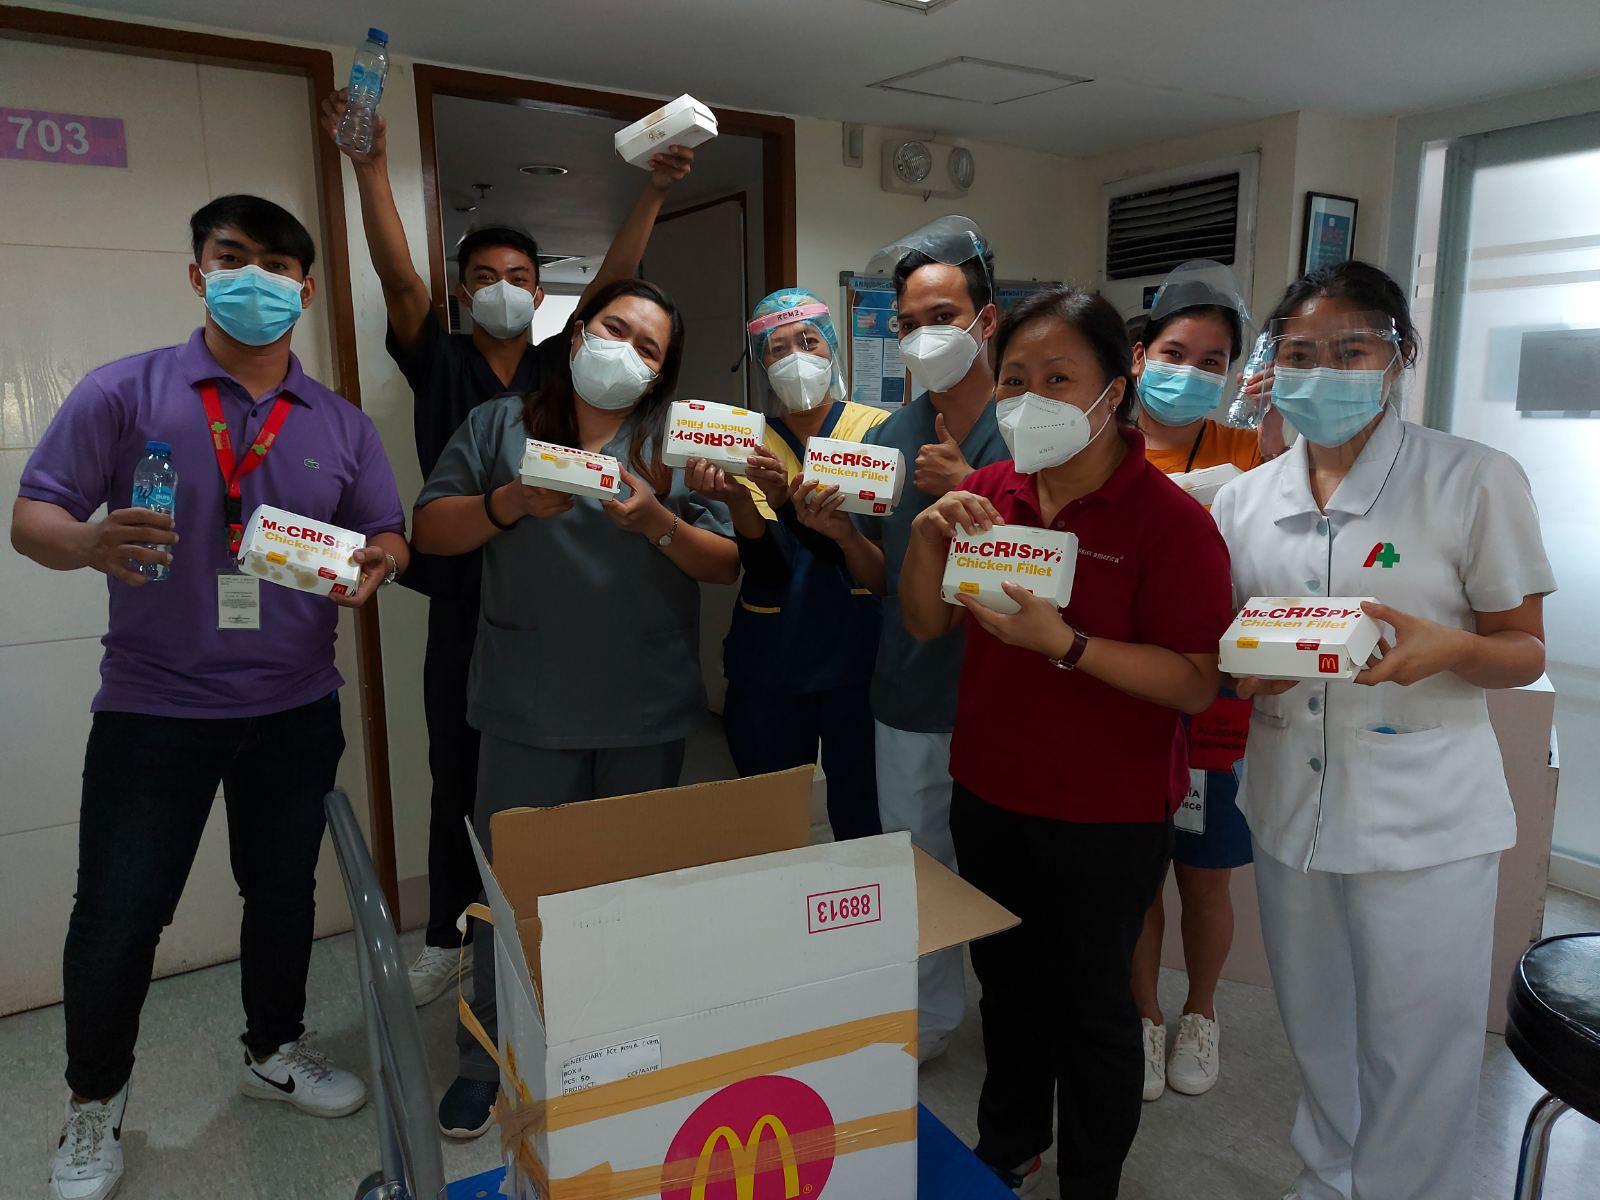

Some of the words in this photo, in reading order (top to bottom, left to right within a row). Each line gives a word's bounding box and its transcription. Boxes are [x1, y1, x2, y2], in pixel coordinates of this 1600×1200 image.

[8, 116, 89, 155] 703
[676, 418, 704, 430] Fillet
[707, 421, 752, 435] Chicken
[675, 429, 755, 448] McCRISPY
[810, 451, 891, 471] McCRISPY
[812, 463, 858, 478] Chicken
[861, 469, 889, 482] Fillet
[264, 531, 319, 554] Chicken
[954, 541, 1056, 563] McCRISPY
[956, 556, 1013, 573] Chicken
[1016, 562, 1053, 577] Fillet
[1241, 607, 1357, 619] McCRISPY
[1240, 619, 1303, 629] Chicken
[1306, 620, 1348, 629] Fillet
[817, 894, 870, 923] 88913
